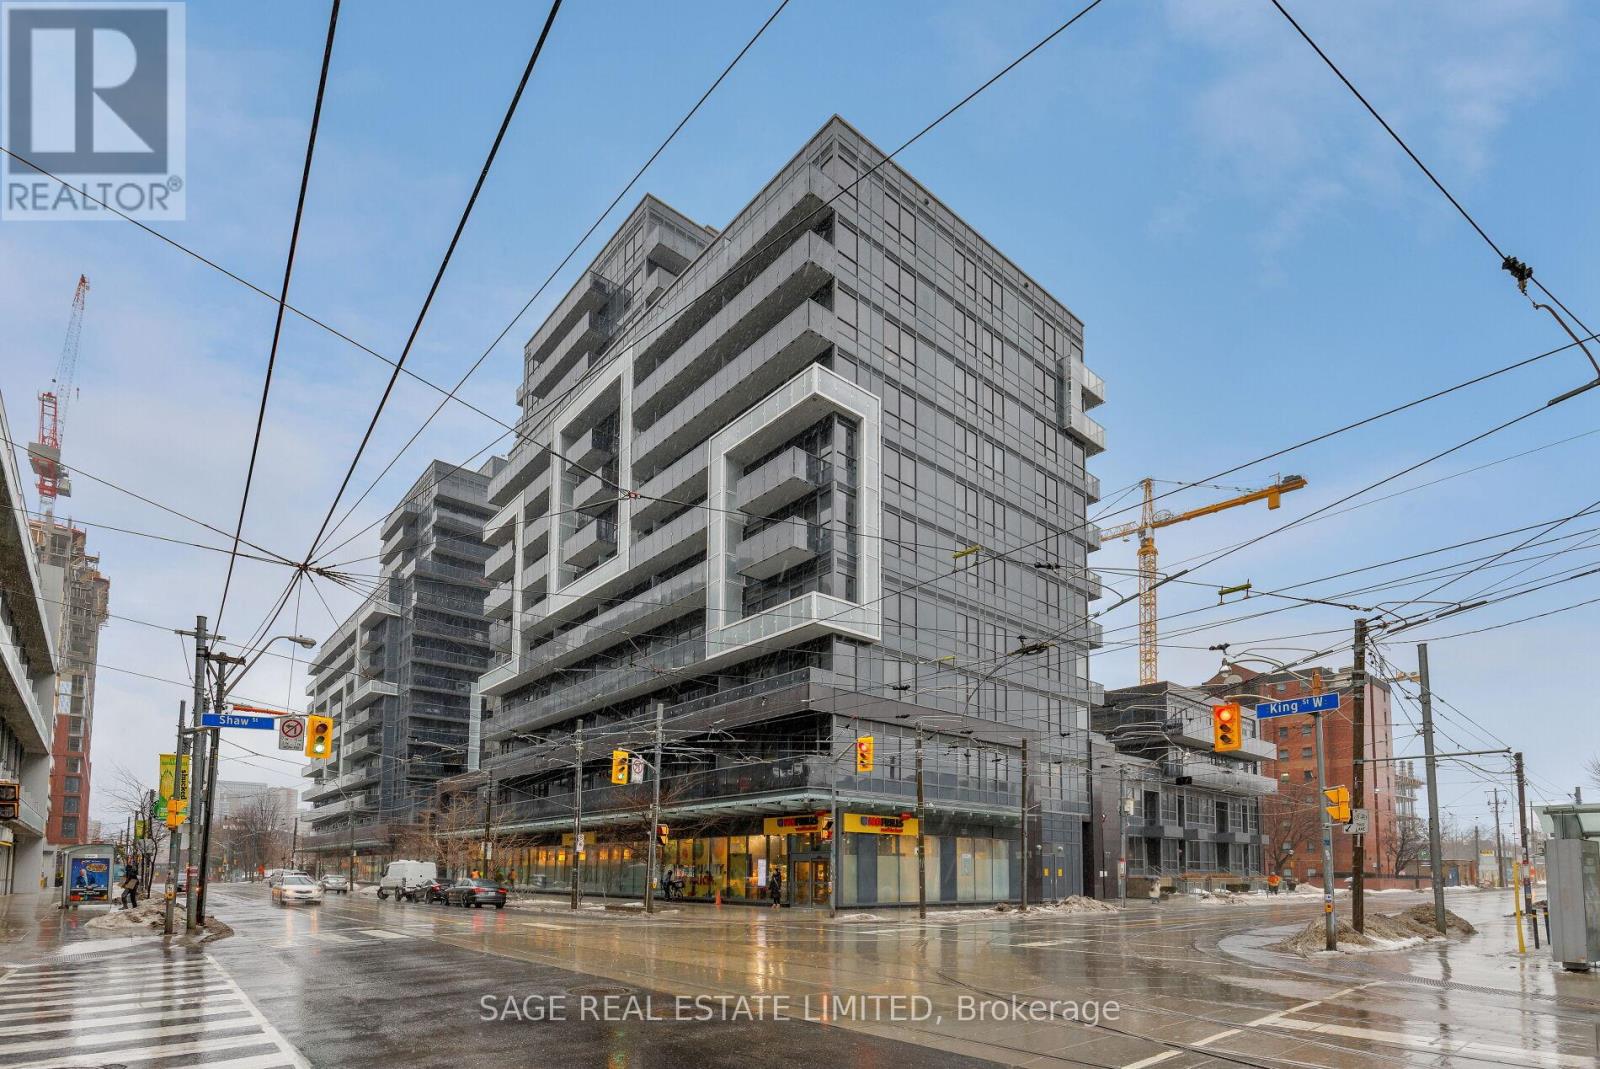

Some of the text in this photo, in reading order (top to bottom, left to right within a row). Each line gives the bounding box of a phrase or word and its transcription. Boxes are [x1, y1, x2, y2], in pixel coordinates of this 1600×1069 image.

[1270, 703, 1298, 714] King
[1313, 697, 1323, 708] W
[219, 716, 249, 726] Shaw
